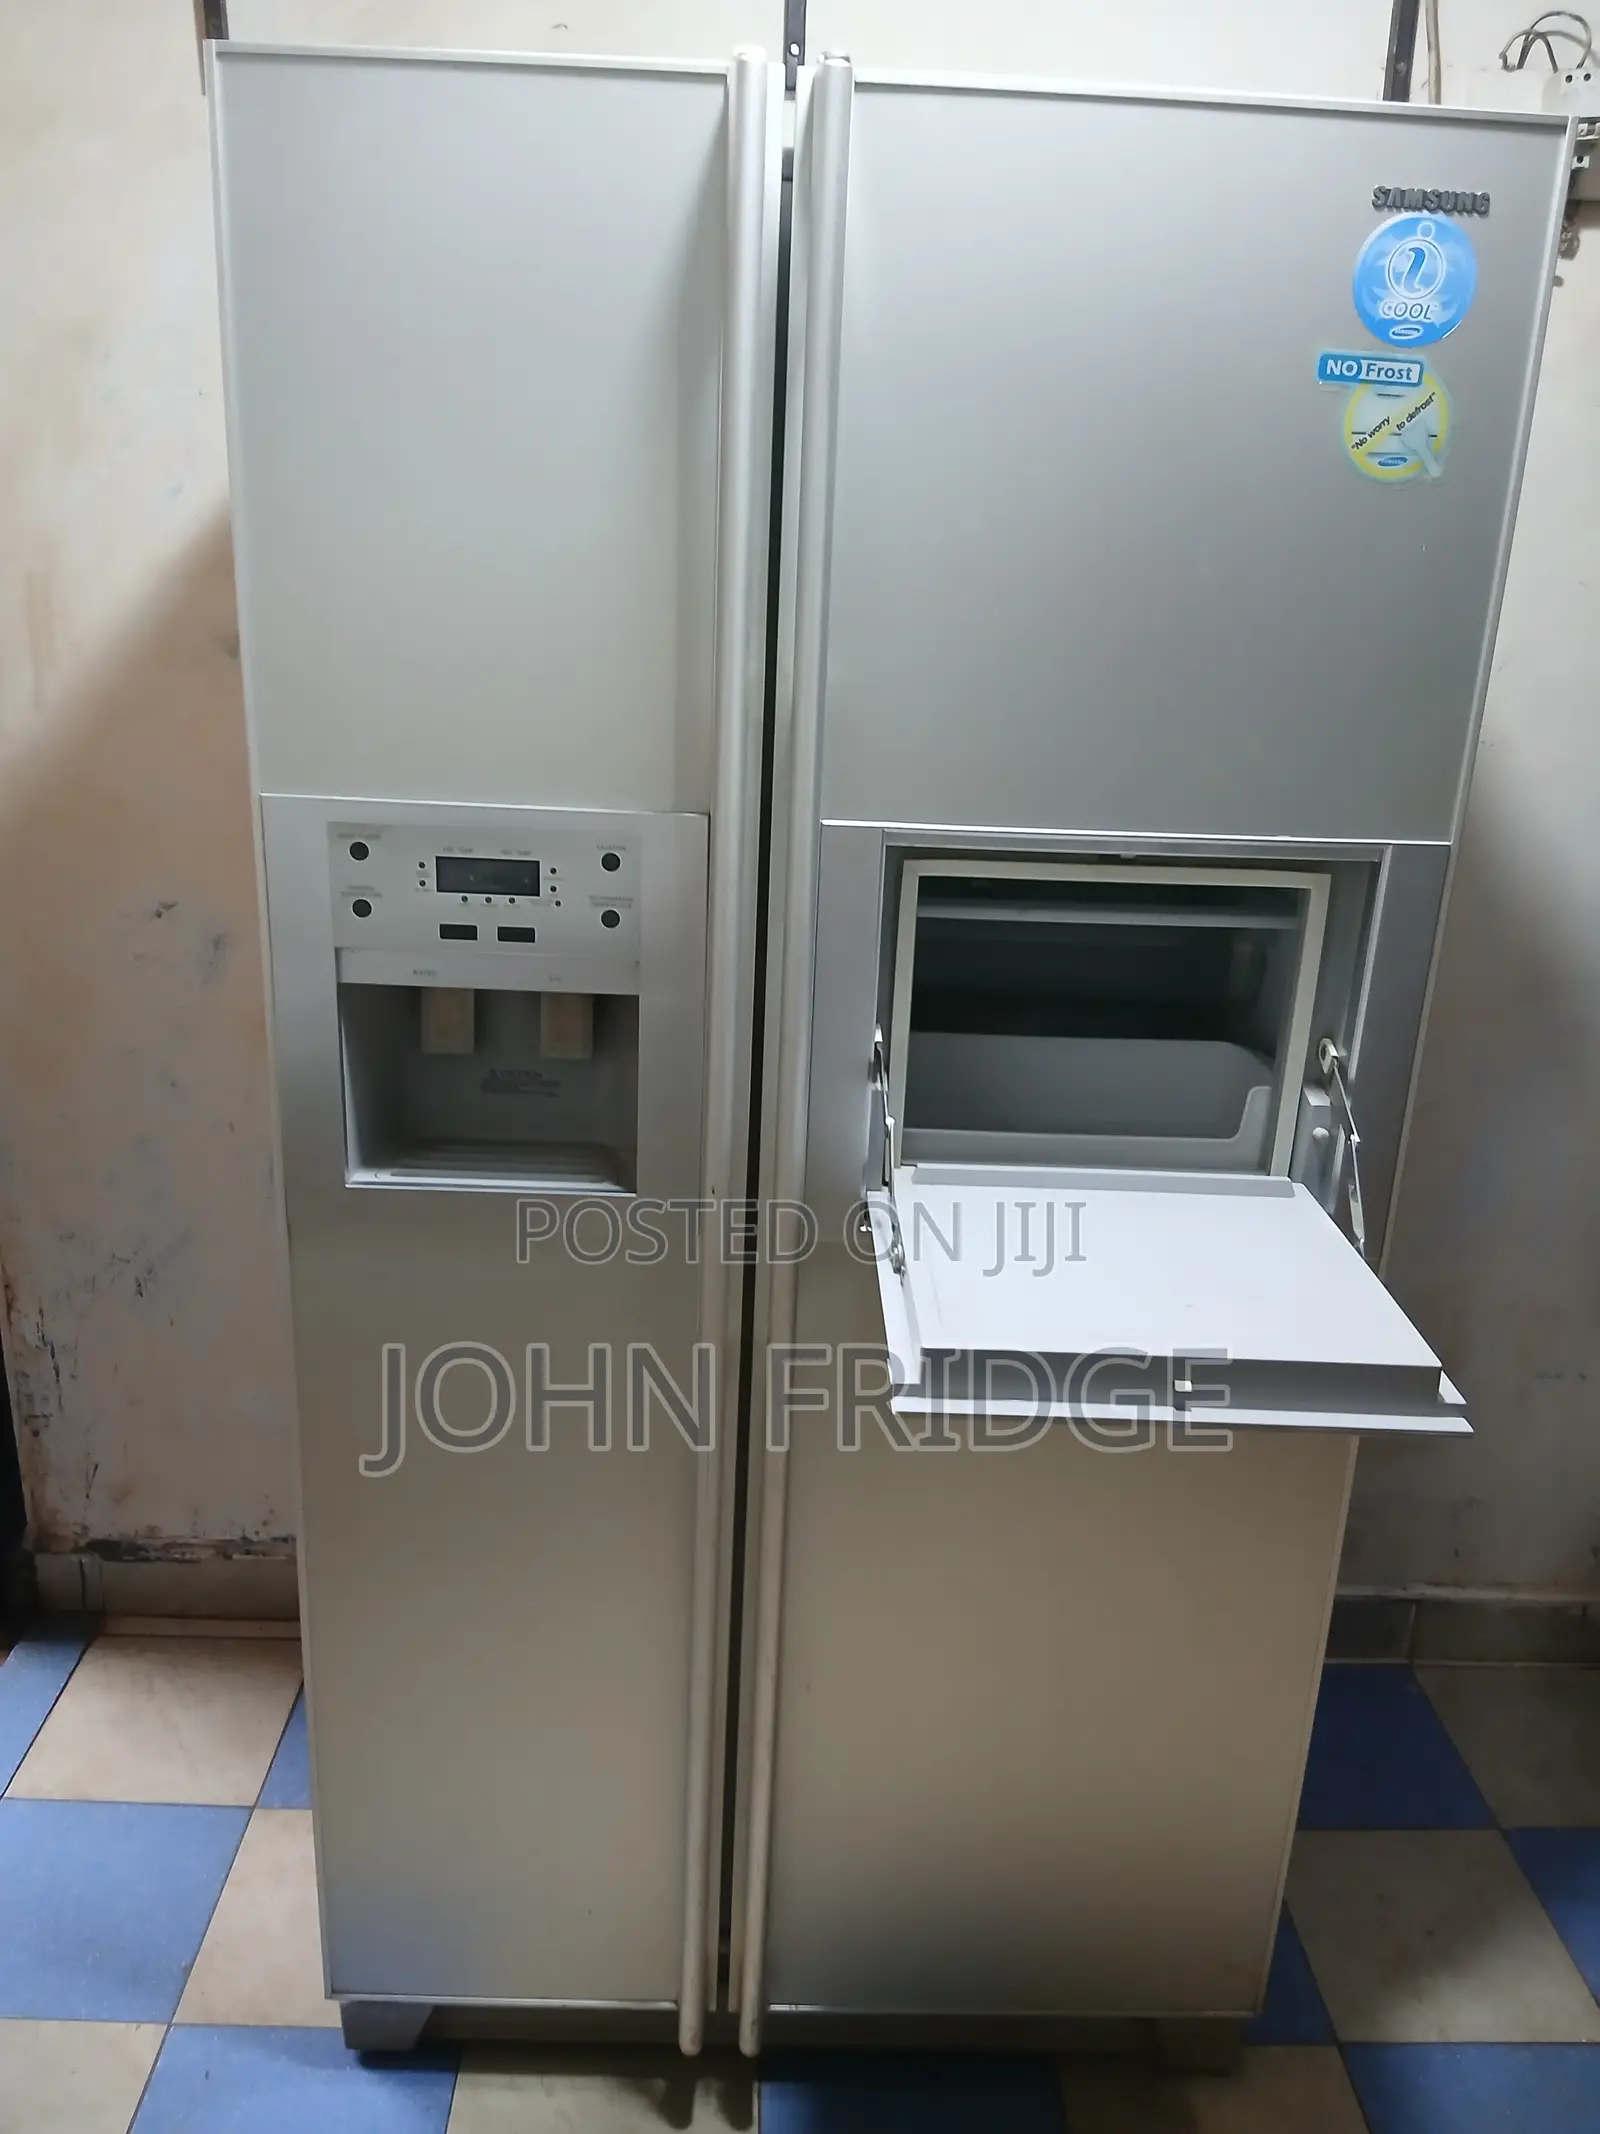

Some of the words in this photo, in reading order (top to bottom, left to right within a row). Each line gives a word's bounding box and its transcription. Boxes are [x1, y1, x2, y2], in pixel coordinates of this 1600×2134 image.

[1372, 186, 1491, 216] SAMSUNG
[1381, 300, 1432, 320] COOL
[1326, 359, 1358, 377] NO
[1365, 362, 1413, 380] Frost
[1367, 416, 1391, 438] worry
[1396, 421, 1406, 431] to
